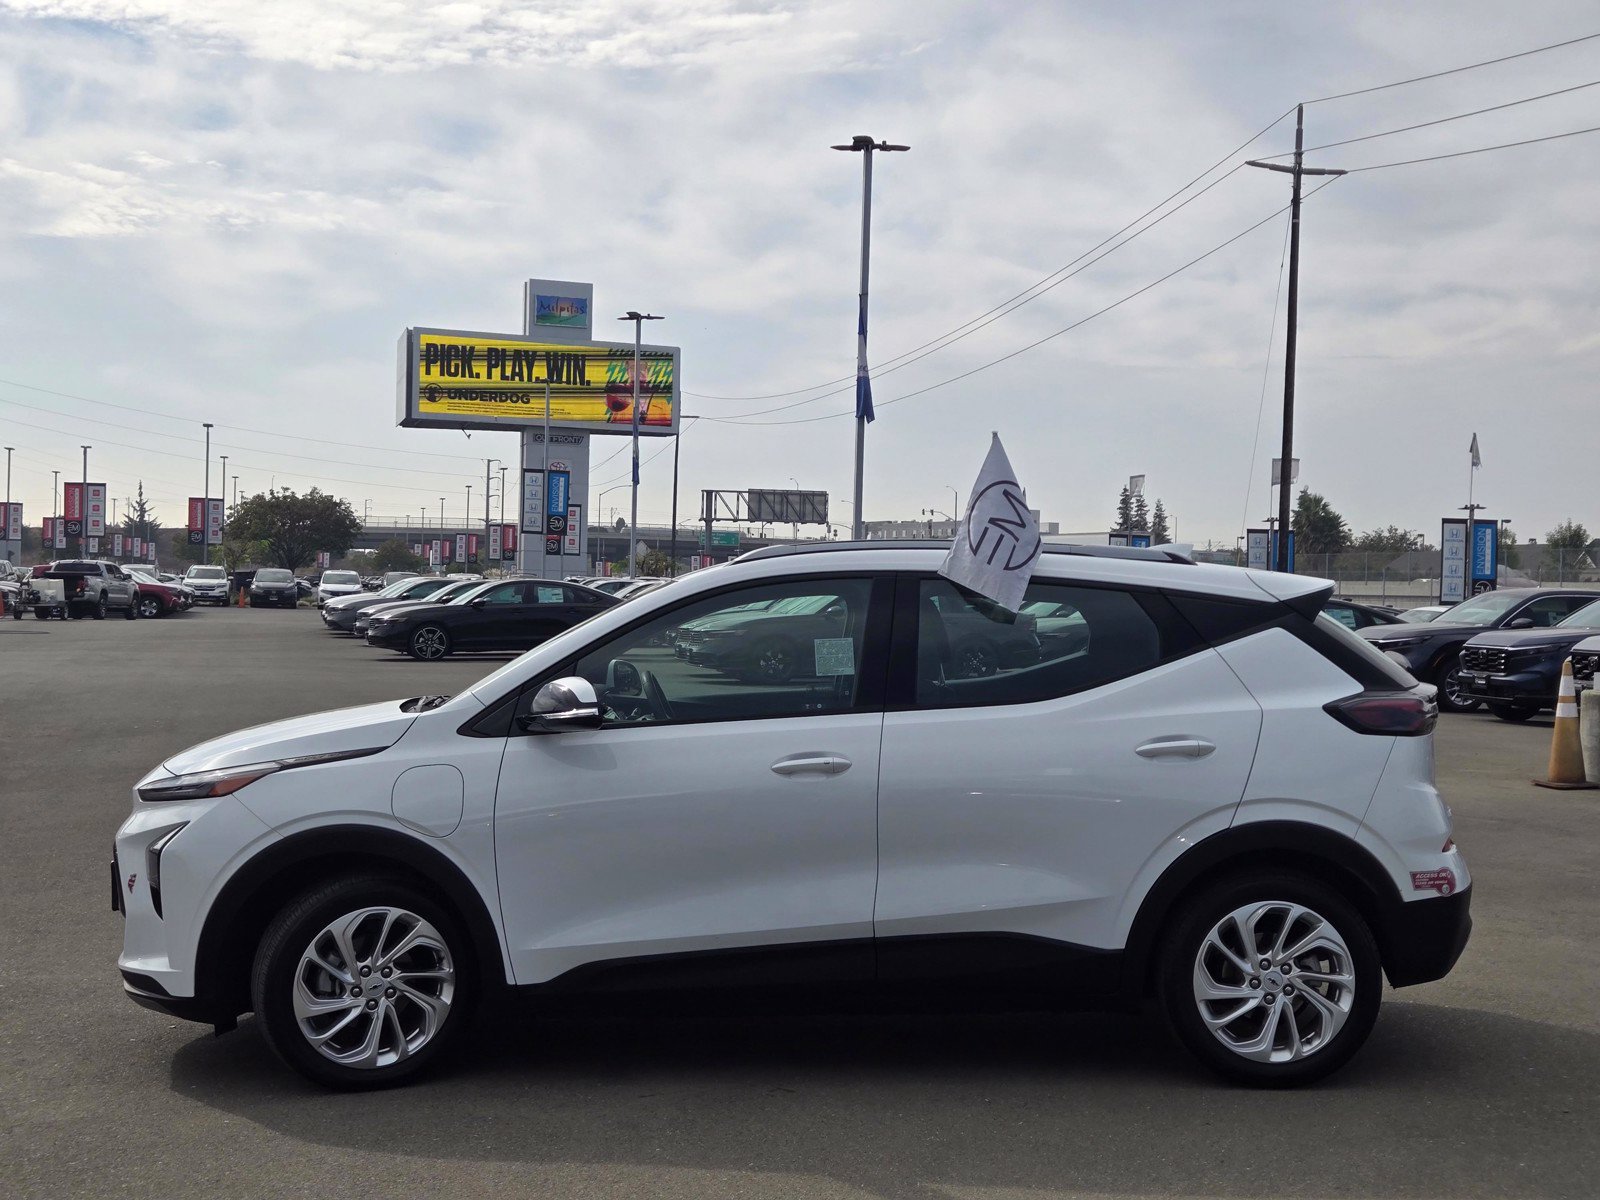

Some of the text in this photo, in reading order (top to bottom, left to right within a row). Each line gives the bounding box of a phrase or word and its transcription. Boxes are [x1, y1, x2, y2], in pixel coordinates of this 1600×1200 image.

[537, 298, 585, 317] Milpitas
[425, 343, 591, 387] PICK. PLAY. WIN.
[447, 388, 531, 404] UNDERDOG
[551, 476, 560, 512] ENVISION
[1476, 528, 1486, 575] ENVISION
